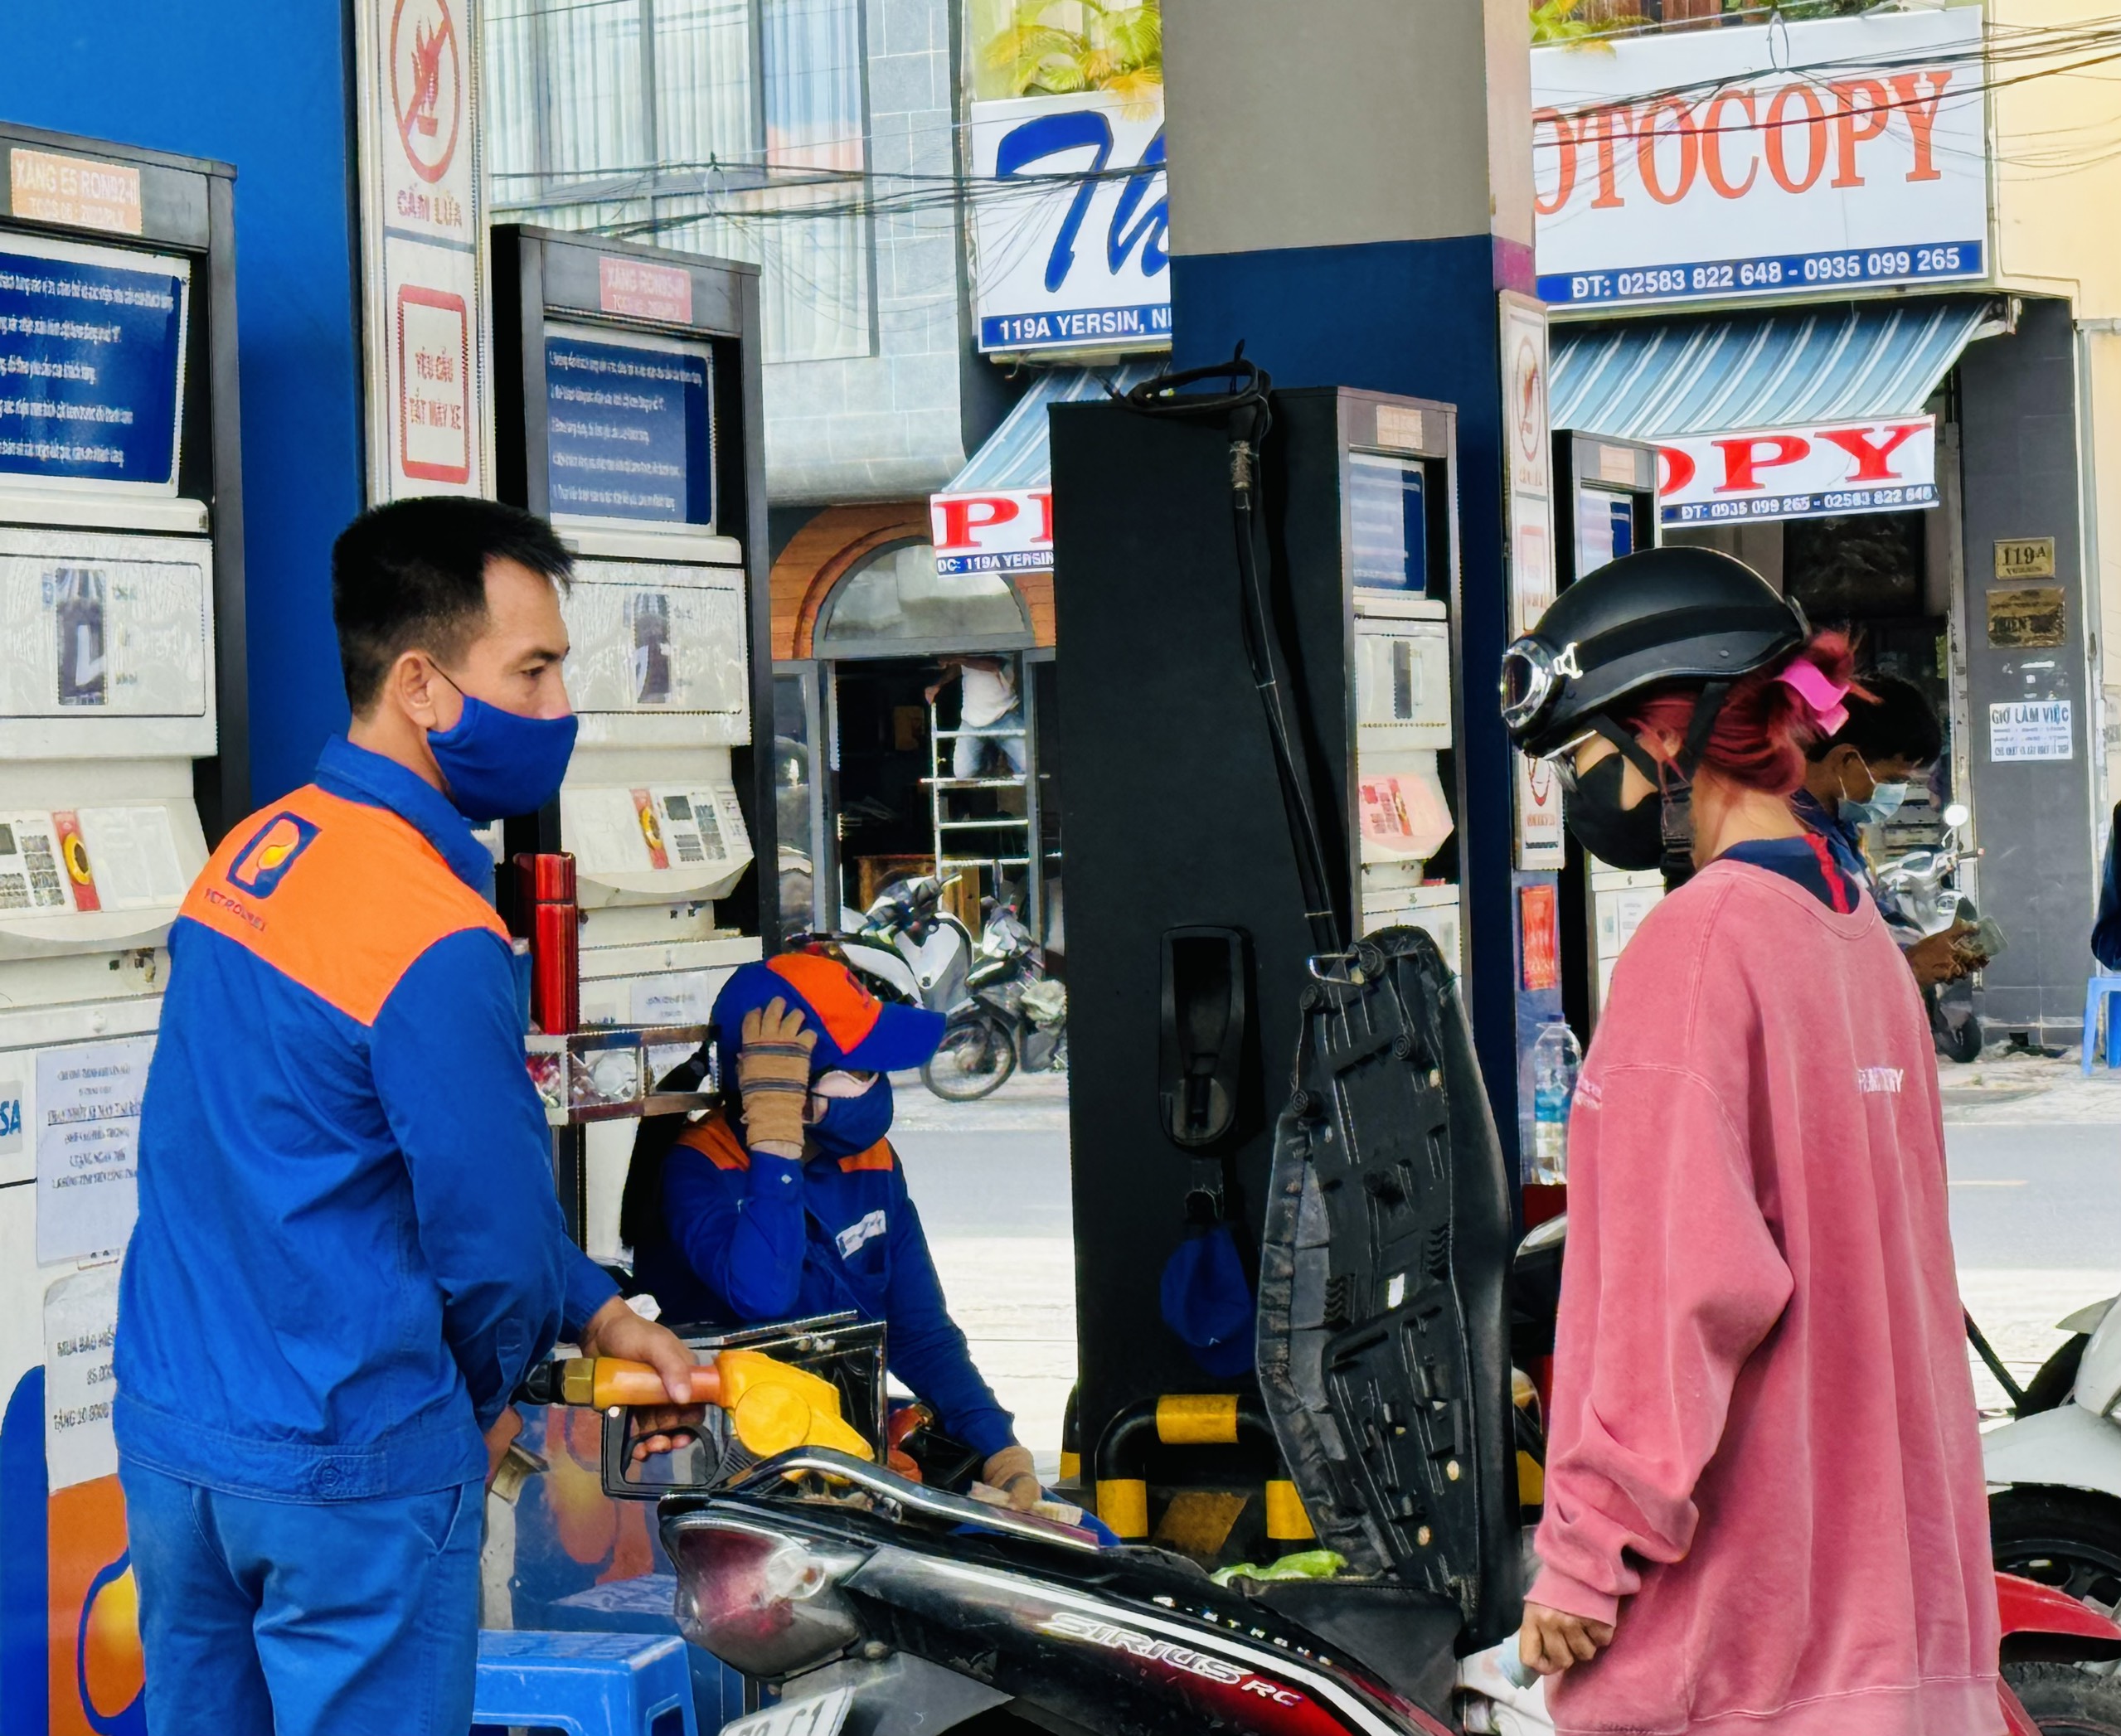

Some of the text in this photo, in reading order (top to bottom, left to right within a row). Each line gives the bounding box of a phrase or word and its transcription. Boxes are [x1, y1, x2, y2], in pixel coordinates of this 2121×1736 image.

[1532, 71, 1953, 216] OTOCOPY
[1572, 275, 1611, 298] ĐT:
[1618, 269, 1686, 295] 02583
[1692, 265, 1733, 289] 822
[1740, 261, 1782, 285] 648
[1803, 255, 1860, 280] 0935
[1867, 251, 1910, 276] 099
[1917, 247, 1960, 271] 265
[1000, 317, 1051, 340] 119A
[1056, 310, 1144, 335] YERSIN,
[933, 494, 1053, 549] P
[1752, 498, 1779, 514] 099
[1783, 496, 1810, 512] 265
[1873, 487, 1904, 504] 822
[966, 555, 1001, 570] 119A
[1037, 1612, 1302, 1706] SIRIUS RC
